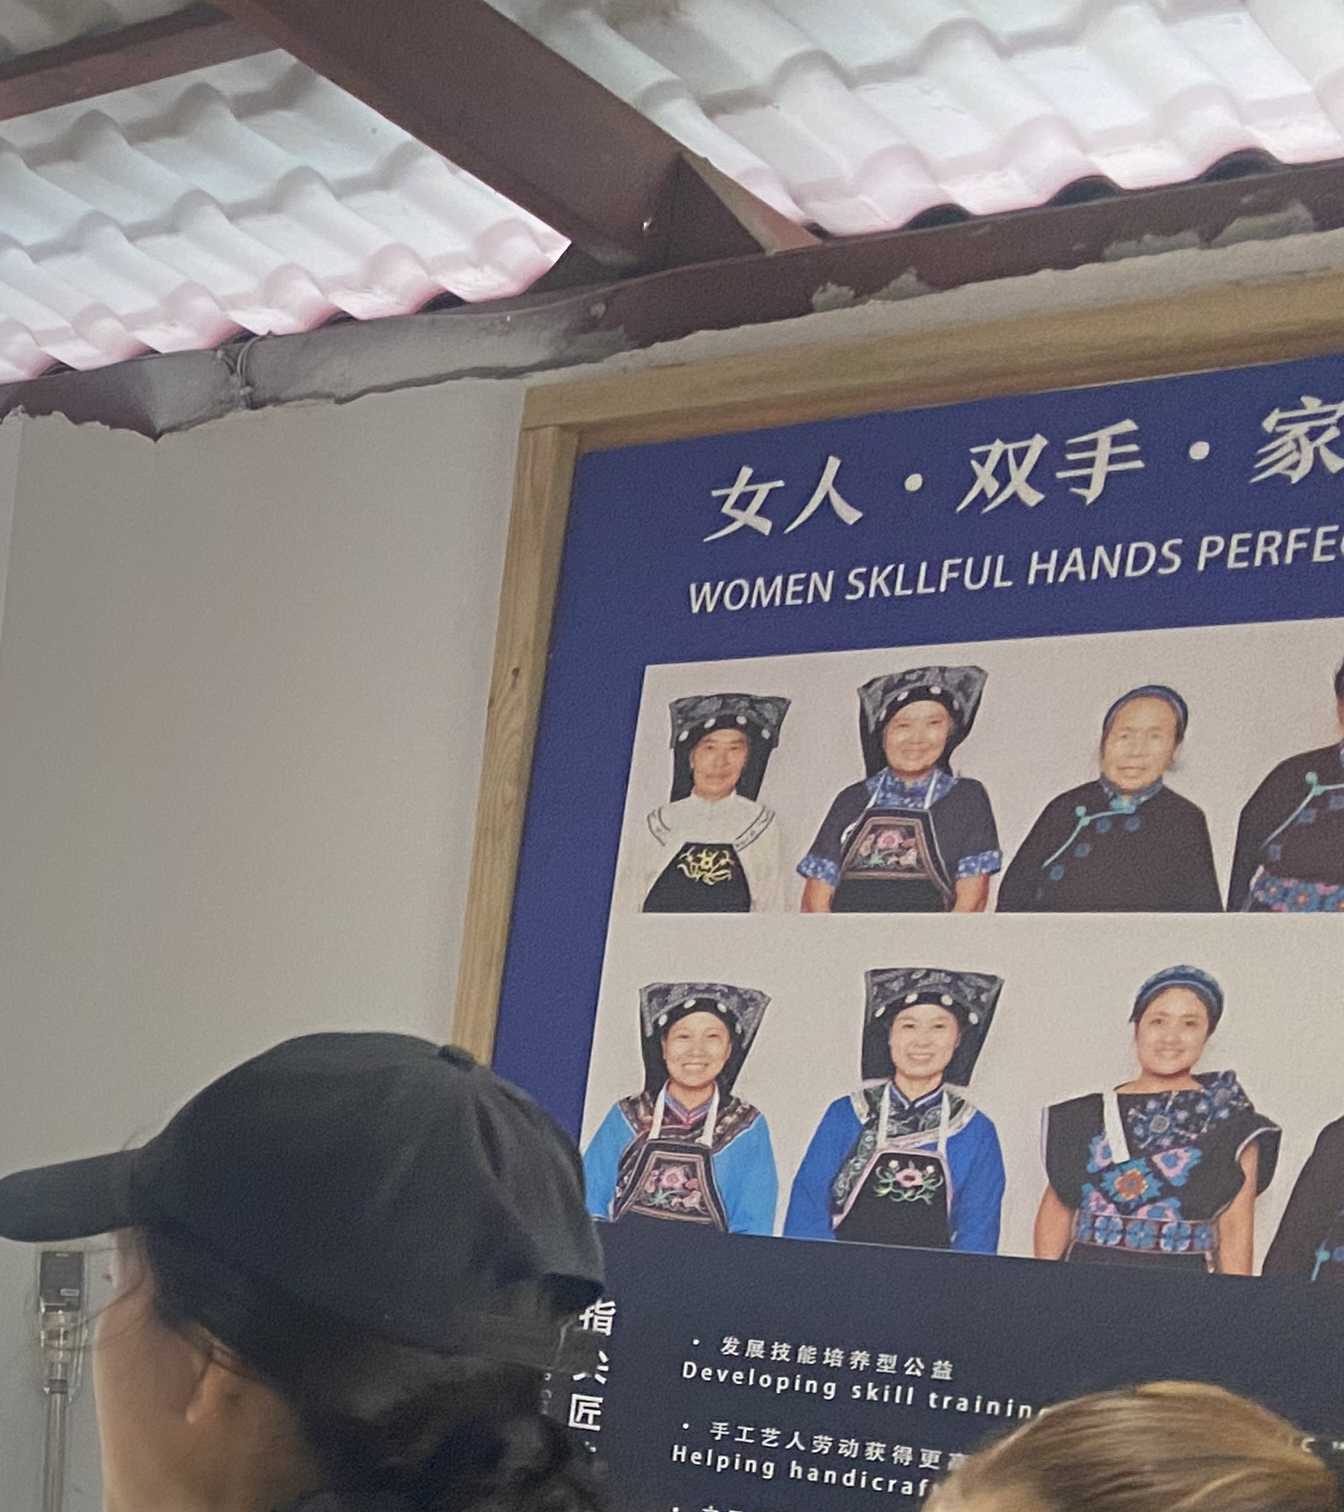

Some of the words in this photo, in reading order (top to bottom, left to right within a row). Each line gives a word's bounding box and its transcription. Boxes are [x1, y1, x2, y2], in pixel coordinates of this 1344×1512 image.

[689, 570, 835, 614] WOMEN
[844, 554, 1014, 600] SKLLFUL
[1027, 537, 1184, 585] HANDS
[1197, 524, 1344, 571] PERFE
[720, 1336, 953, 1380] 发展技能培养型公益
[682, 1361, 837, 1400] Developing
[851, 1382, 914, 1405] skill
[928, 1392, 1043, 1419] trainin
[672, 1444, 776, 1480] Helping
[789, 1460, 932, 1497] handicraf
